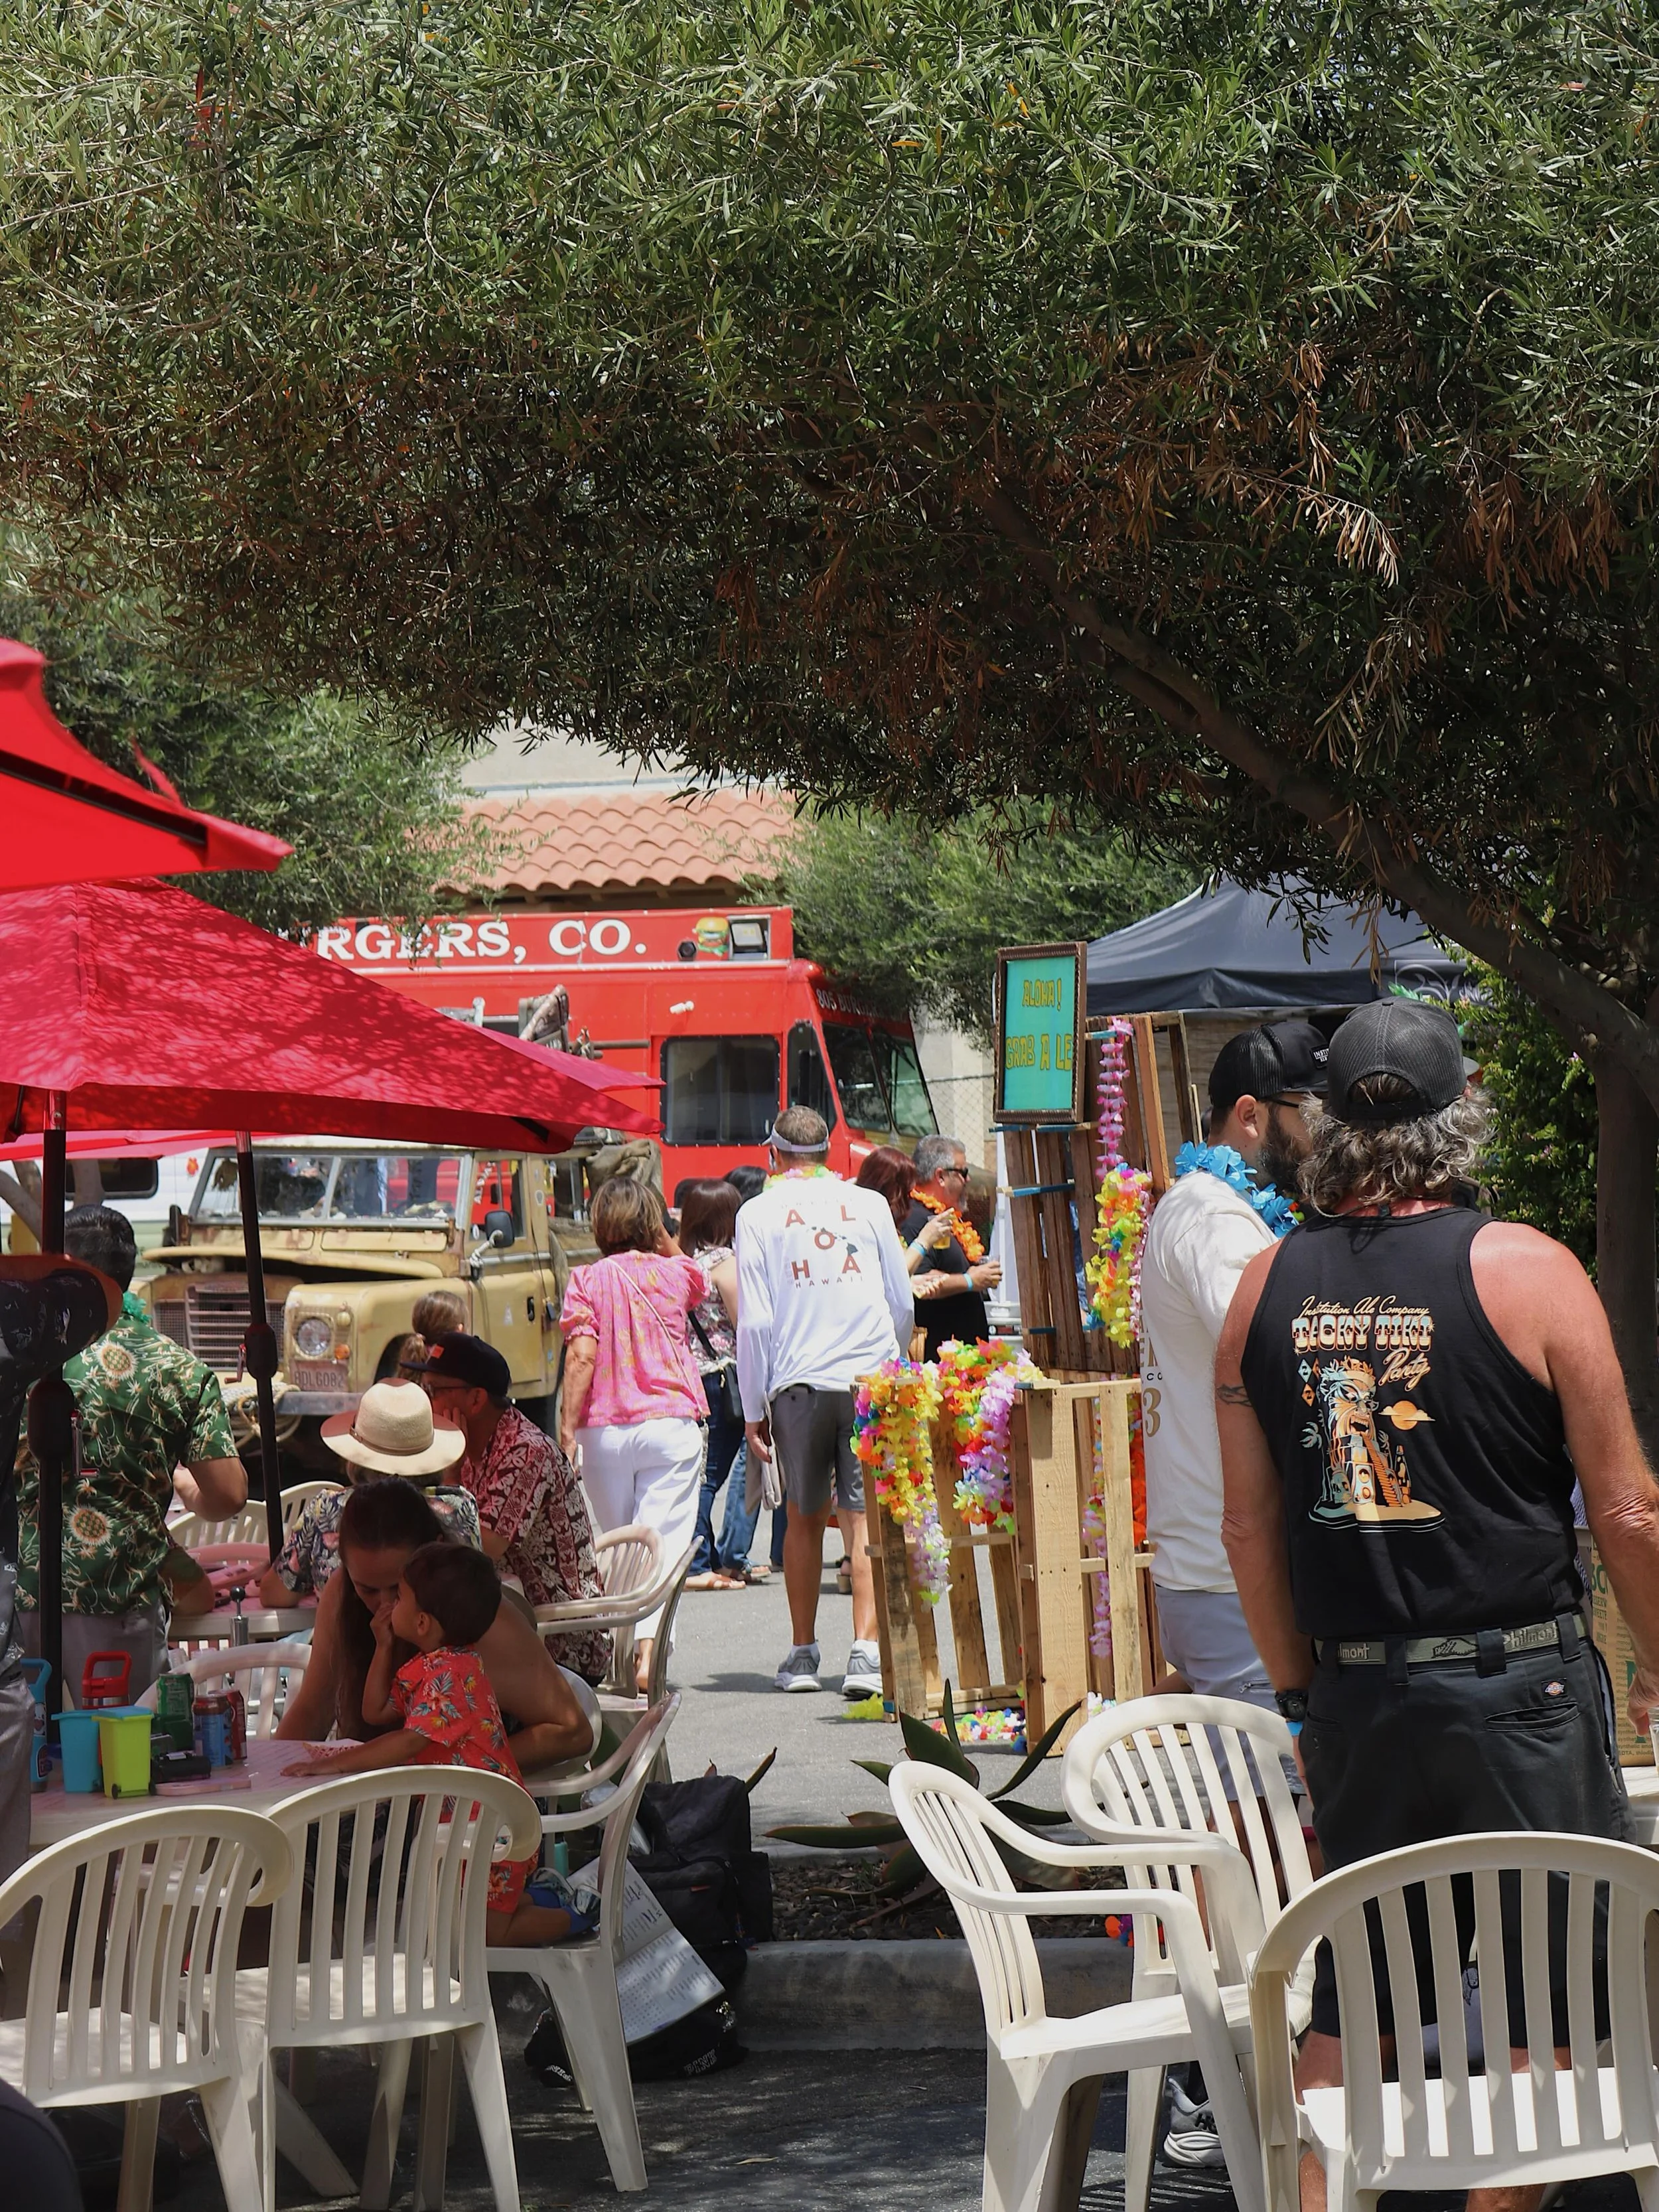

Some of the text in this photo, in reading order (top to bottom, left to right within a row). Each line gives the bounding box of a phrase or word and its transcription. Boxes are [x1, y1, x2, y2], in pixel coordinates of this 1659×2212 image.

[548, 919, 647, 955] CO.
[816, 988, 837, 1011] 805
[1022, 978, 1062, 1011] ALOHA!
[1005, 1034, 1035, 1070] GRAB
[1040, 1033, 1050, 1070] A
[796, 1276, 863, 1289] HAWAII
[1353, 1295, 1381, 1314] Ale
[1379, 1295, 1430, 1322] Company
[1291, 1314, 1433, 1353] TACKY TIKI
[1378, 1347, 1432, 1392] Party
[683, 2048, 717, 2077] PINK
